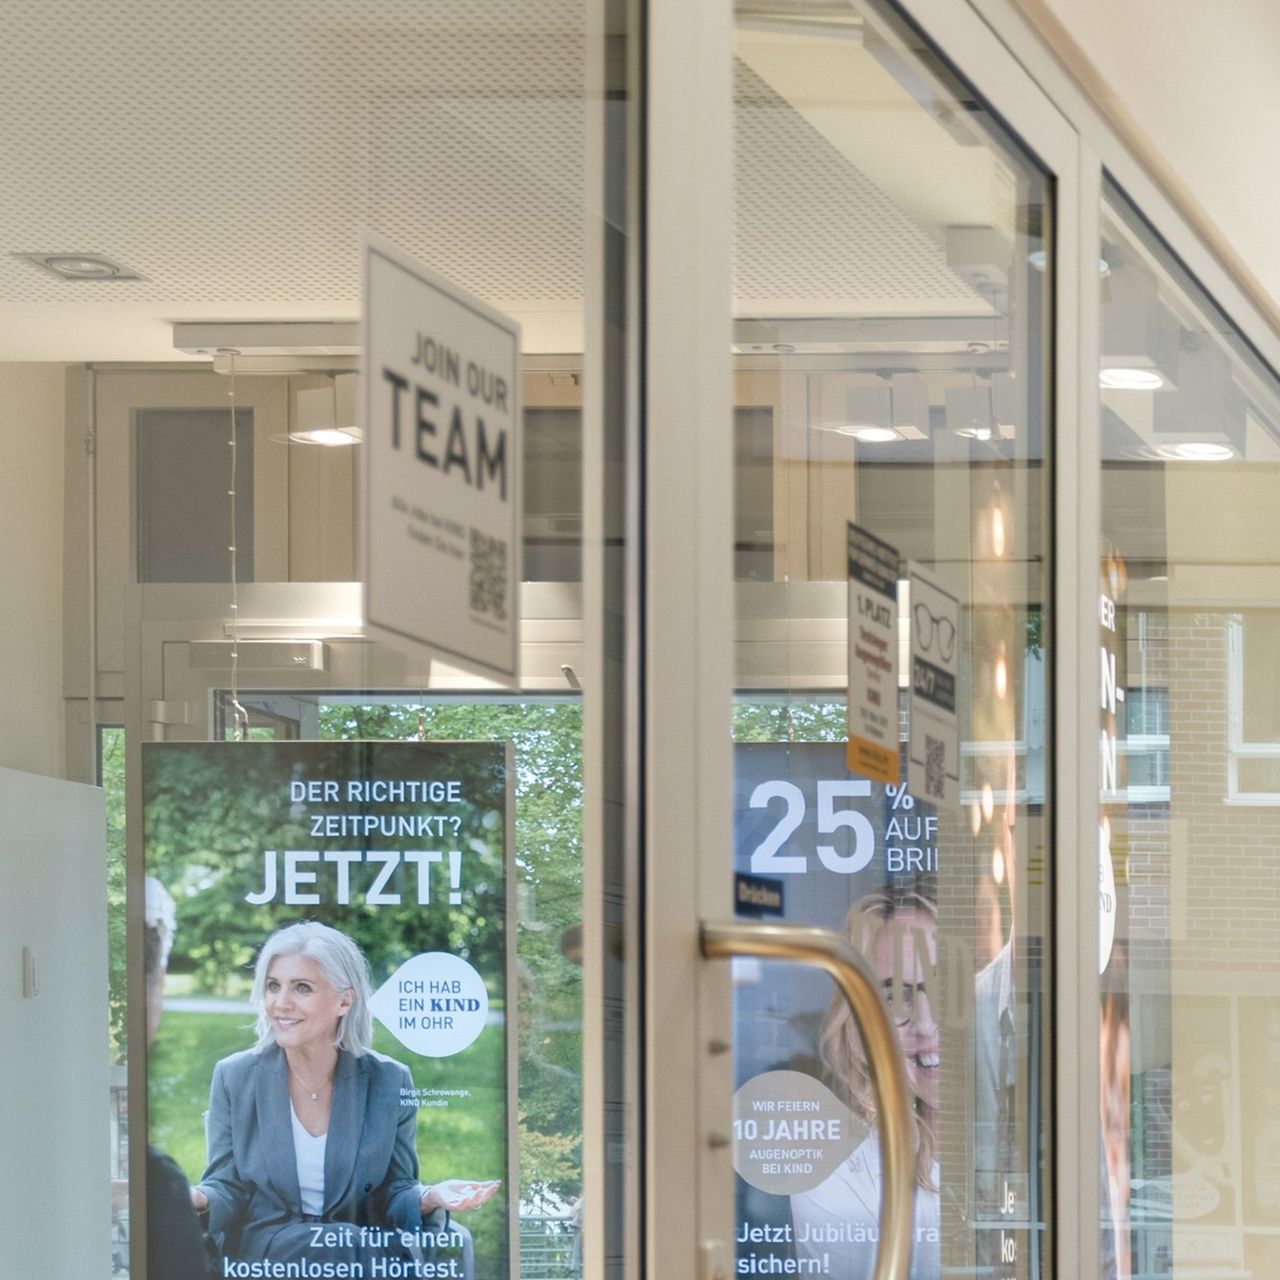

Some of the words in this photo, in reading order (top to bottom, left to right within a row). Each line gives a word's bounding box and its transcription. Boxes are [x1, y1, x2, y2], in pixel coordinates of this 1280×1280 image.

[411, 331, 461, 388] JOIN
[466, 360, 508, 415] OUR
[382, 366, 508, 502] TEAM
[865, 596, 891, 630] PLATZ
[290, 781, 340, 802] DER
[347, 781, 462, 802] RICHTIGE
[310, 815, 462, 837] ZEITPUNKT?
[749, 780, 875, 874] 25
[886, 782, 914, 810] %
[885, 816, 938, 841] AUF
[245, 851, 463, 906] JETZT!
[399, 981, 424, 994] ICH
[430, 981, 461, 994] HAB
[399, 999, 425, 1012] EIN
[430, 999, 480, 1012] KIND
[399, 1016, 416, 1029] IM
[421, 1016, 454, 1030] OHR
[400, 1088, 420, 1098] Birgit
[400, 1099, 419, 1107] KIND
[421, 1099, 448, 1107] Kundin
[752, 1101, 775, 1111] WIR
[778, 1101, 820, 1111] FEIERN
[733, 1119, 757, 1140] 10
[763, 1119, 841, 1140] JAHRE
[750, 1149, 823, 1160] AUGENOPTIK
[762, 1164, 781, 1174] BEI
[784, 1164, 813, 1174] KIND
[310, 1226, 354, 1248] Zeit
[360, 1226, 395, 1248] für
[402, 1227, 464, 1248] einen
[737, 1222, 792, 1243] Jetzt
[223, 1256, 364, 1279] kostenlosen
[371, 1256, 464, 1279] Hörtest.
[737, 1253, 830, 1274] sichern!
